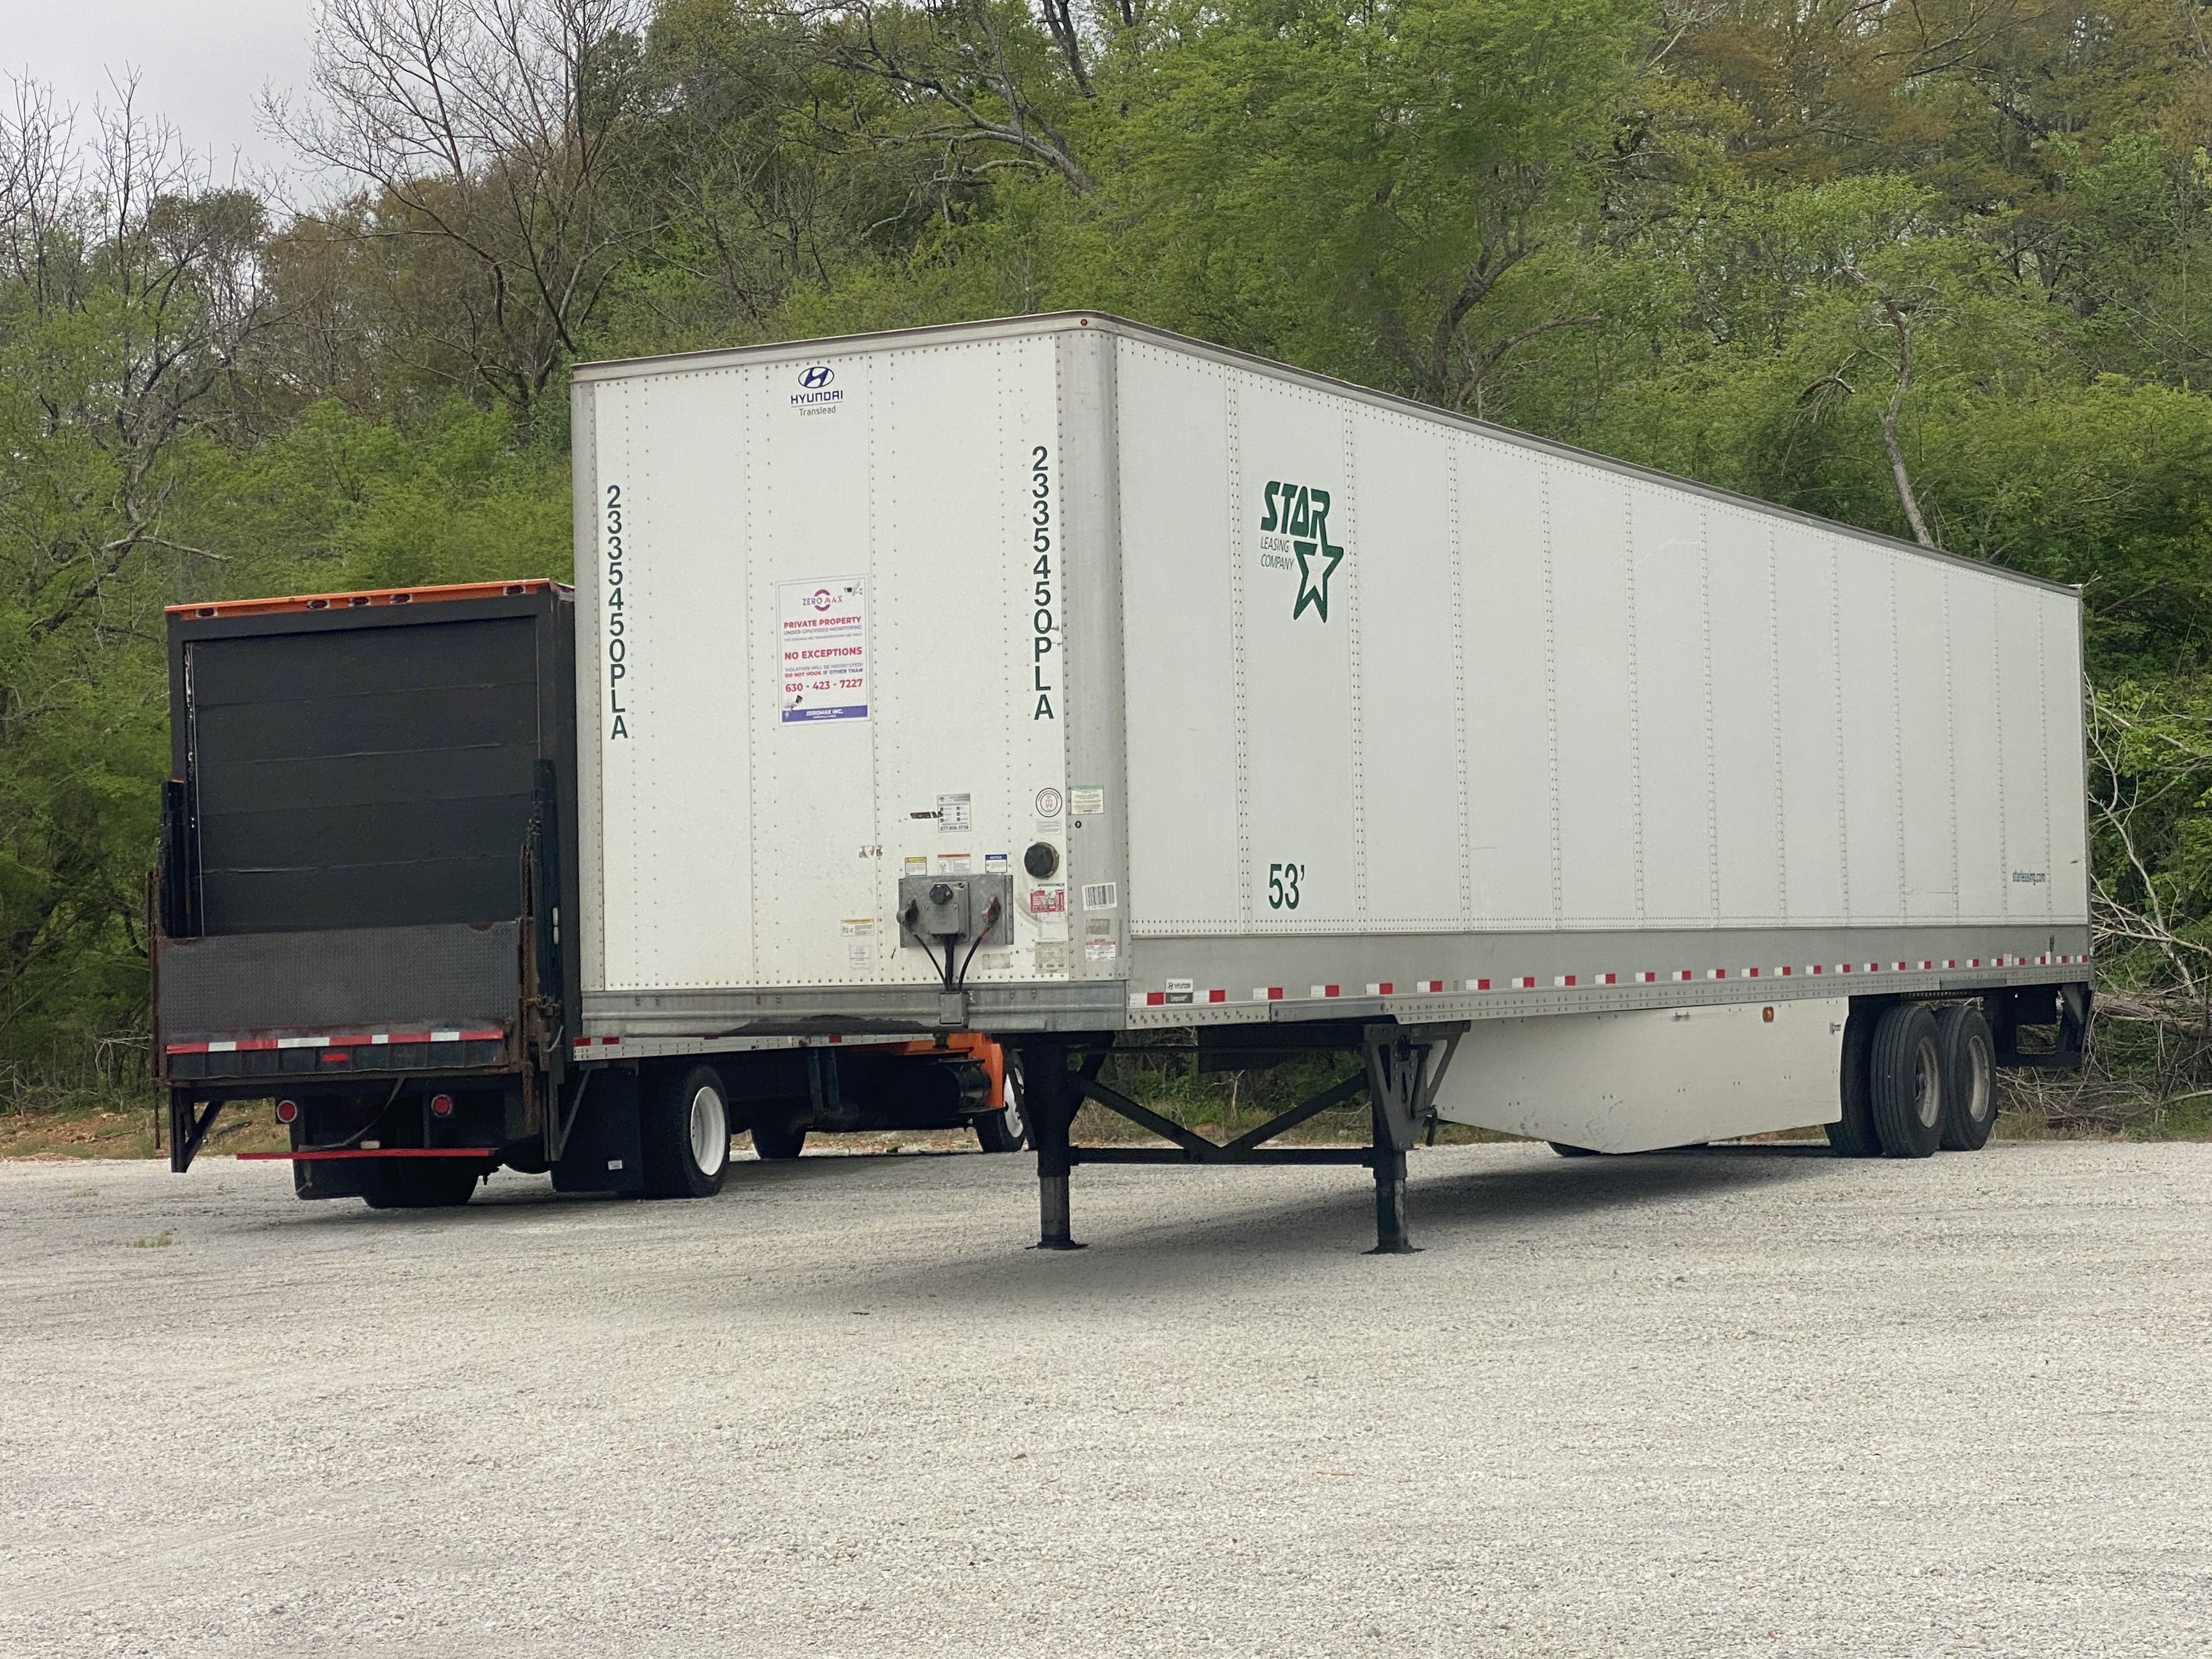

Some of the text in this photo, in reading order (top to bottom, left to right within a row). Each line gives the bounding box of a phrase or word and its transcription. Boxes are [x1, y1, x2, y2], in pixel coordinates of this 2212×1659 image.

[791, 390, 843, 404] HYUNDAI
[799, 405, 836, 416] Translead
[1260, 481, 1330, 539] STAR
[1261, 537, 1290, 553] LEASING
[1261, 554, 1294, 571] COMPANY
[802, 597, 822, 606] ZERO
[784, 617, 861, 629] PRIVATE PROPERTY
[785, 647, 862, 660] NO EXCEPTIONS
[785, 683, 803, 692] 630
[812, 681, 830, 690] 423
[839, 679, 863, 689] 7227
[1268, 864, 1305, 910] 53'
